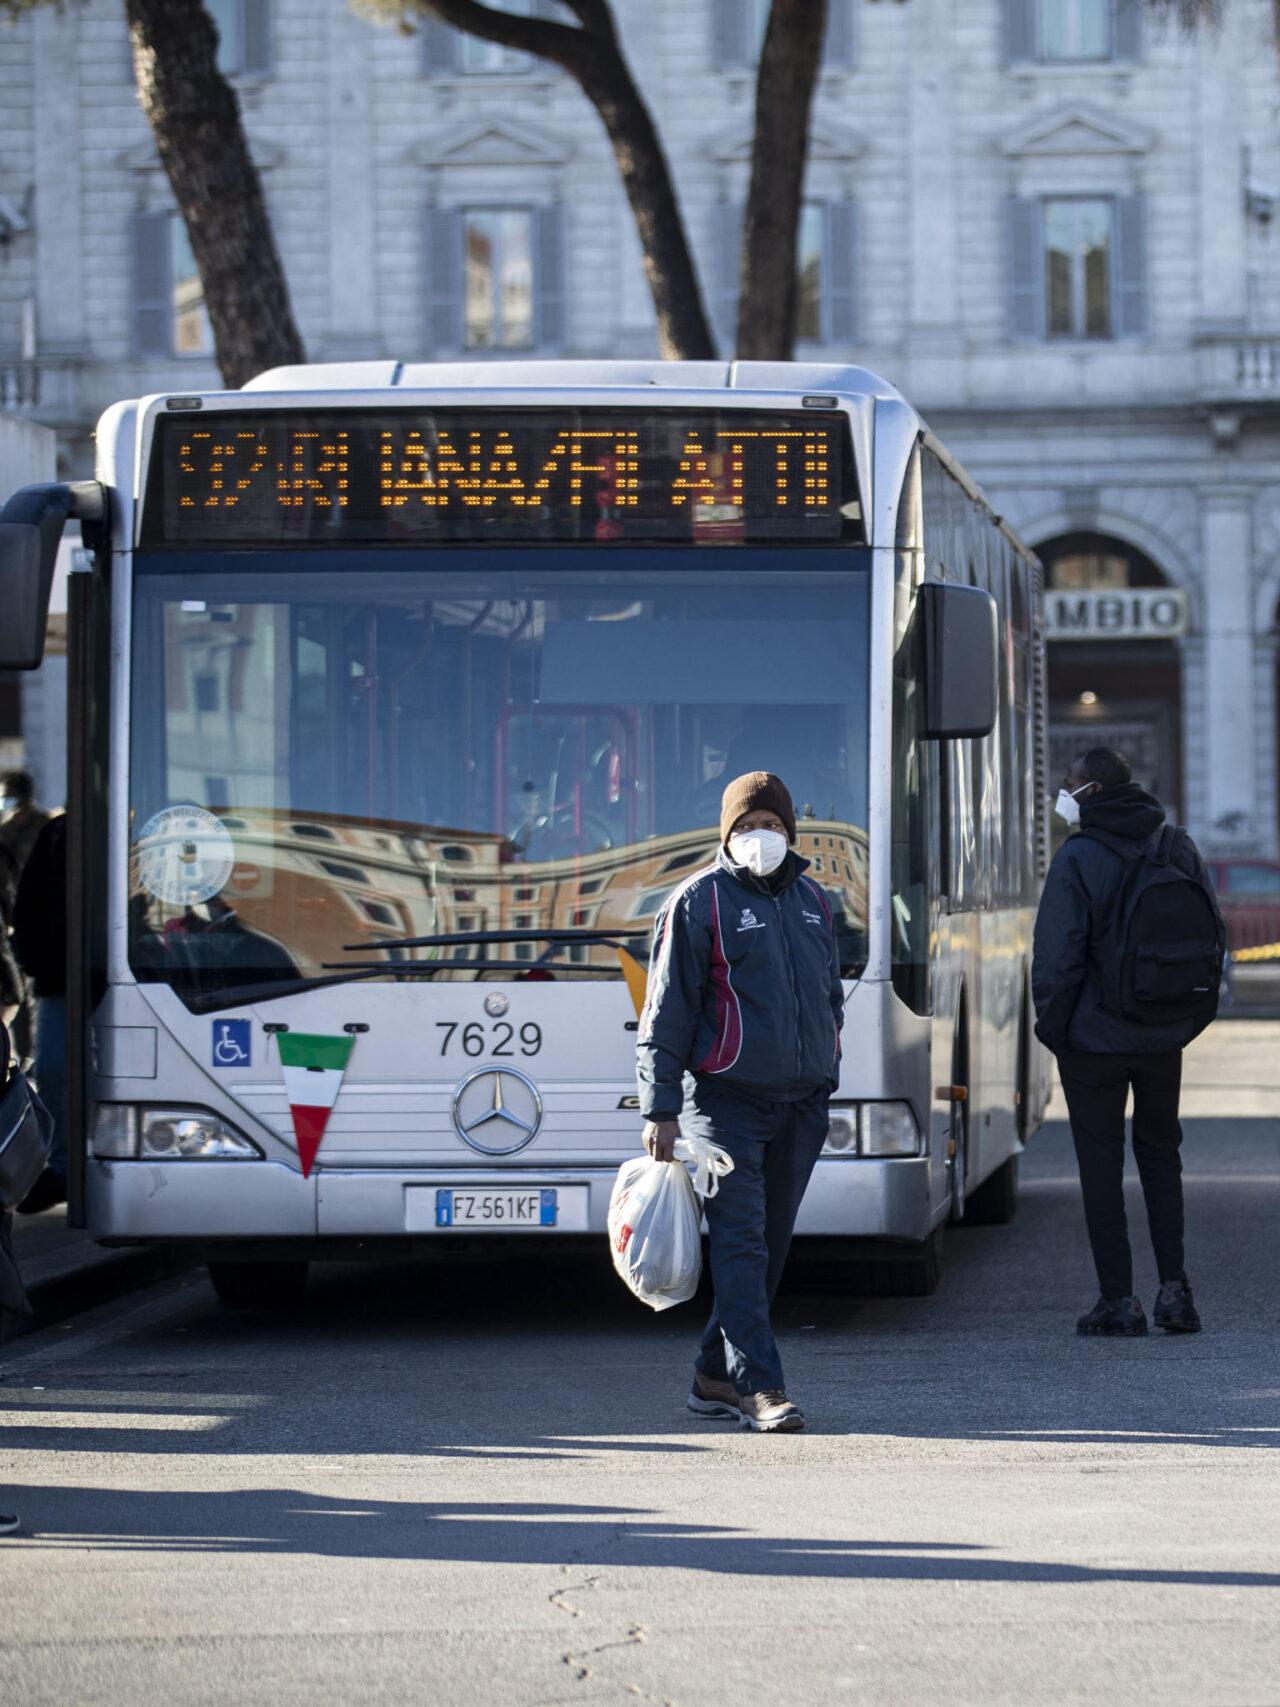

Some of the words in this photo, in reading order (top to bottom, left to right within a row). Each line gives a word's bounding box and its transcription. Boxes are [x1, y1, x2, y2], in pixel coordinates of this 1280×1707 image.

[1043, 597, 1179, 628] MBIO
[435, 1021, 543, 1057] 7629
[453, 1197, 477, 1219] FZ
[482, 1197, 539, 1219] 561KF
